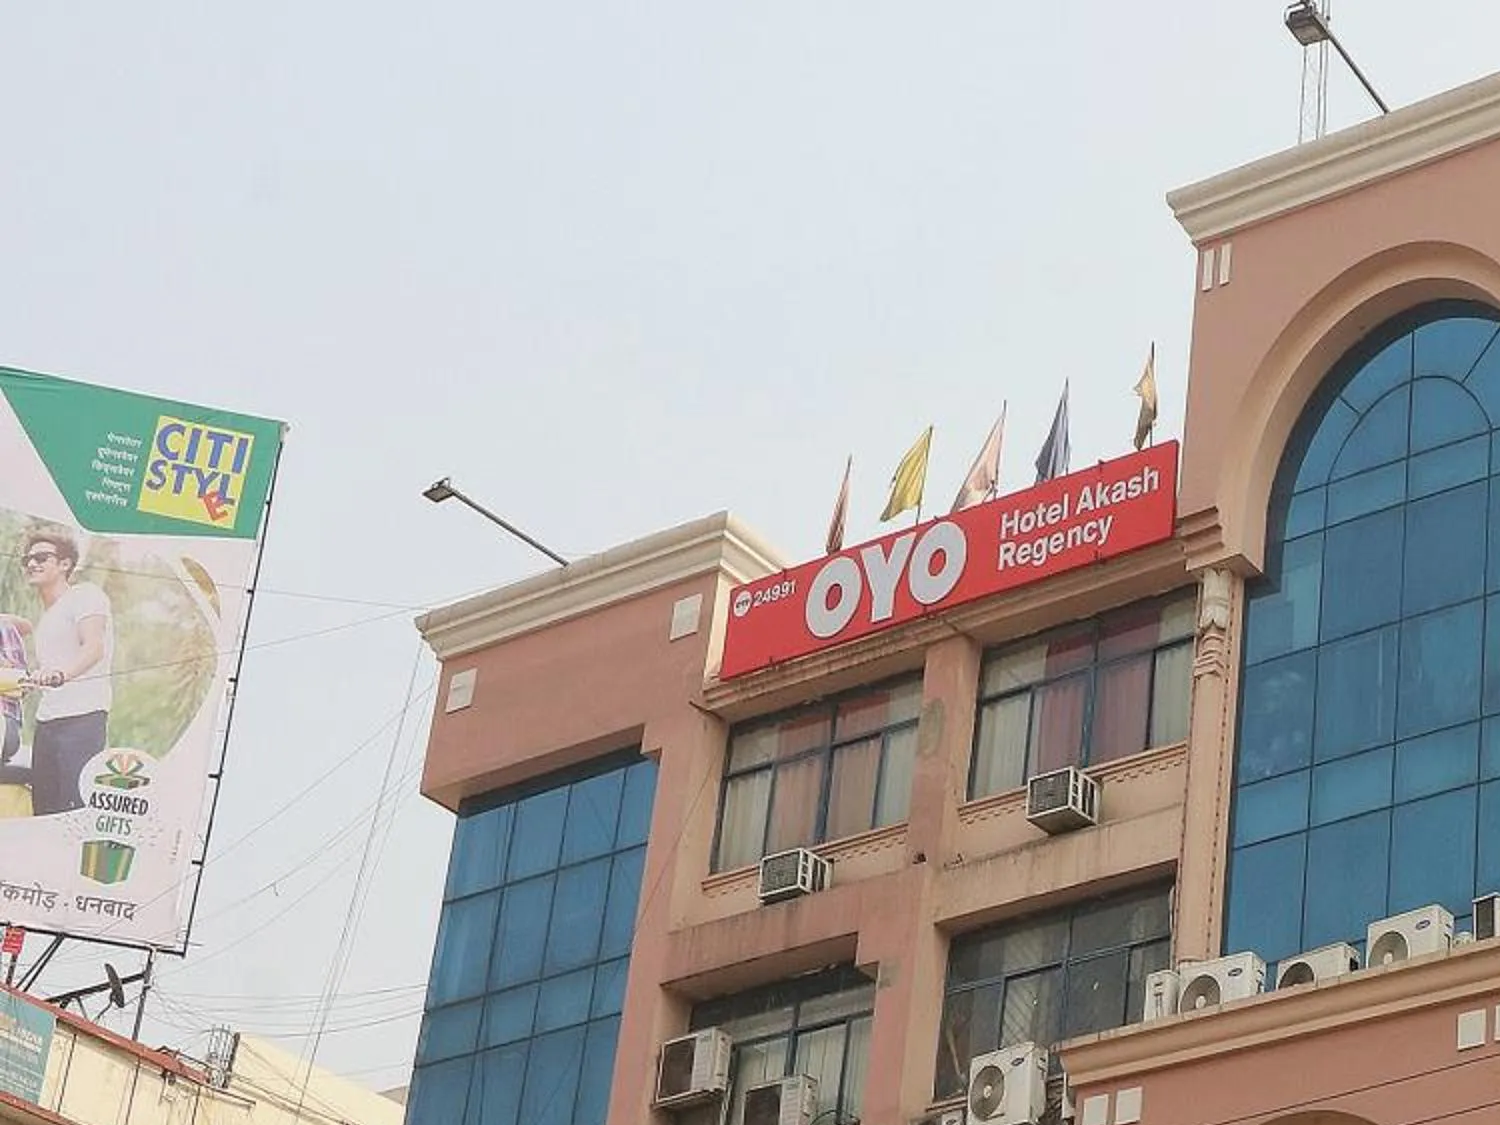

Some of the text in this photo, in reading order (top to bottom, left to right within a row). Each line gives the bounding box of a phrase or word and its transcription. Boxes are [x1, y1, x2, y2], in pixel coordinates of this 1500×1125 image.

[156, 423, 249, 474] CITI
[146, 460, 235, 521] STYLE
[1001, 467, 1159, 540] Hotel Akash
[998, 514, 1113, 571] Regency
[753, 581, 796, 608] 24991
[805, 522, 968, 639] OYO
[88, 792, 149, 815] ASSURED
[95, 815, 133, 836] GIFTS
[75, 895, 138, 920] धनबाद
